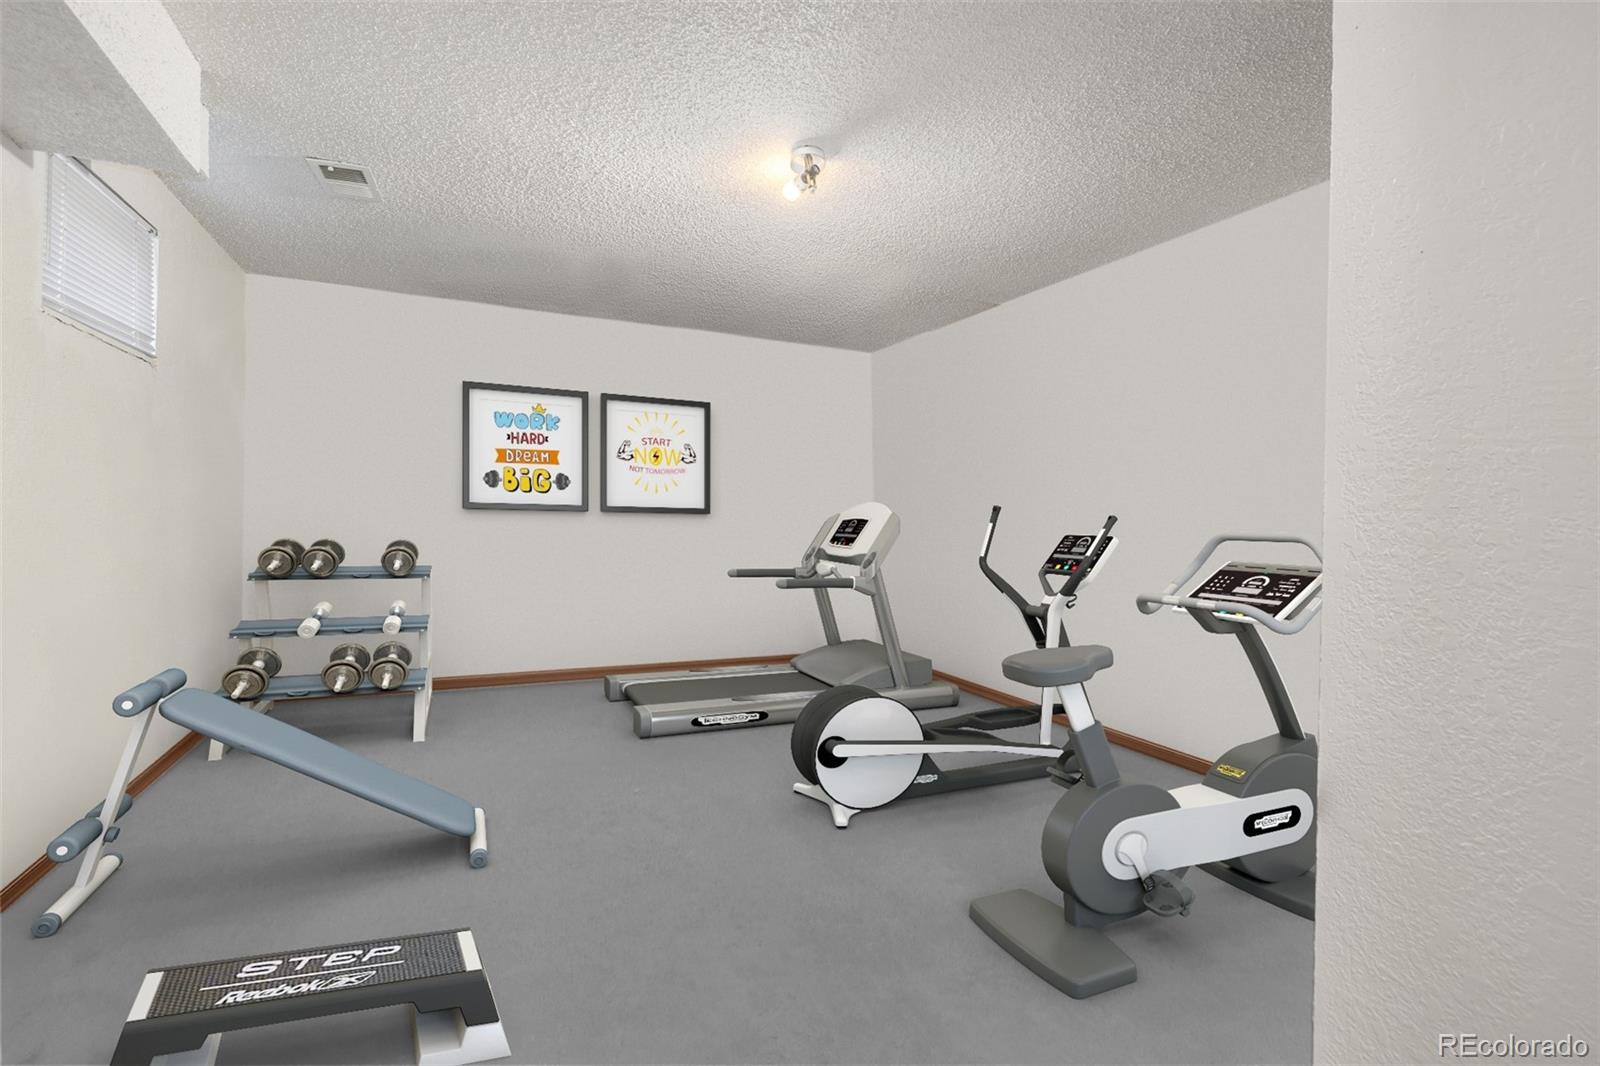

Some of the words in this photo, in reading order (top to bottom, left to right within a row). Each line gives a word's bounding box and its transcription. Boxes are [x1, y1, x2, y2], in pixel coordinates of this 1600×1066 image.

[494, 410, 561, 431] WORK
[510, 431, 545, 445] HARD
[641, 437, 672, 447] START
[633, 447, 681, 466] NOW
[629, 465, 644, 473] NOT
[236, 944, 402, 979] STEP
[214, 979, 325, 1006] Reebok
